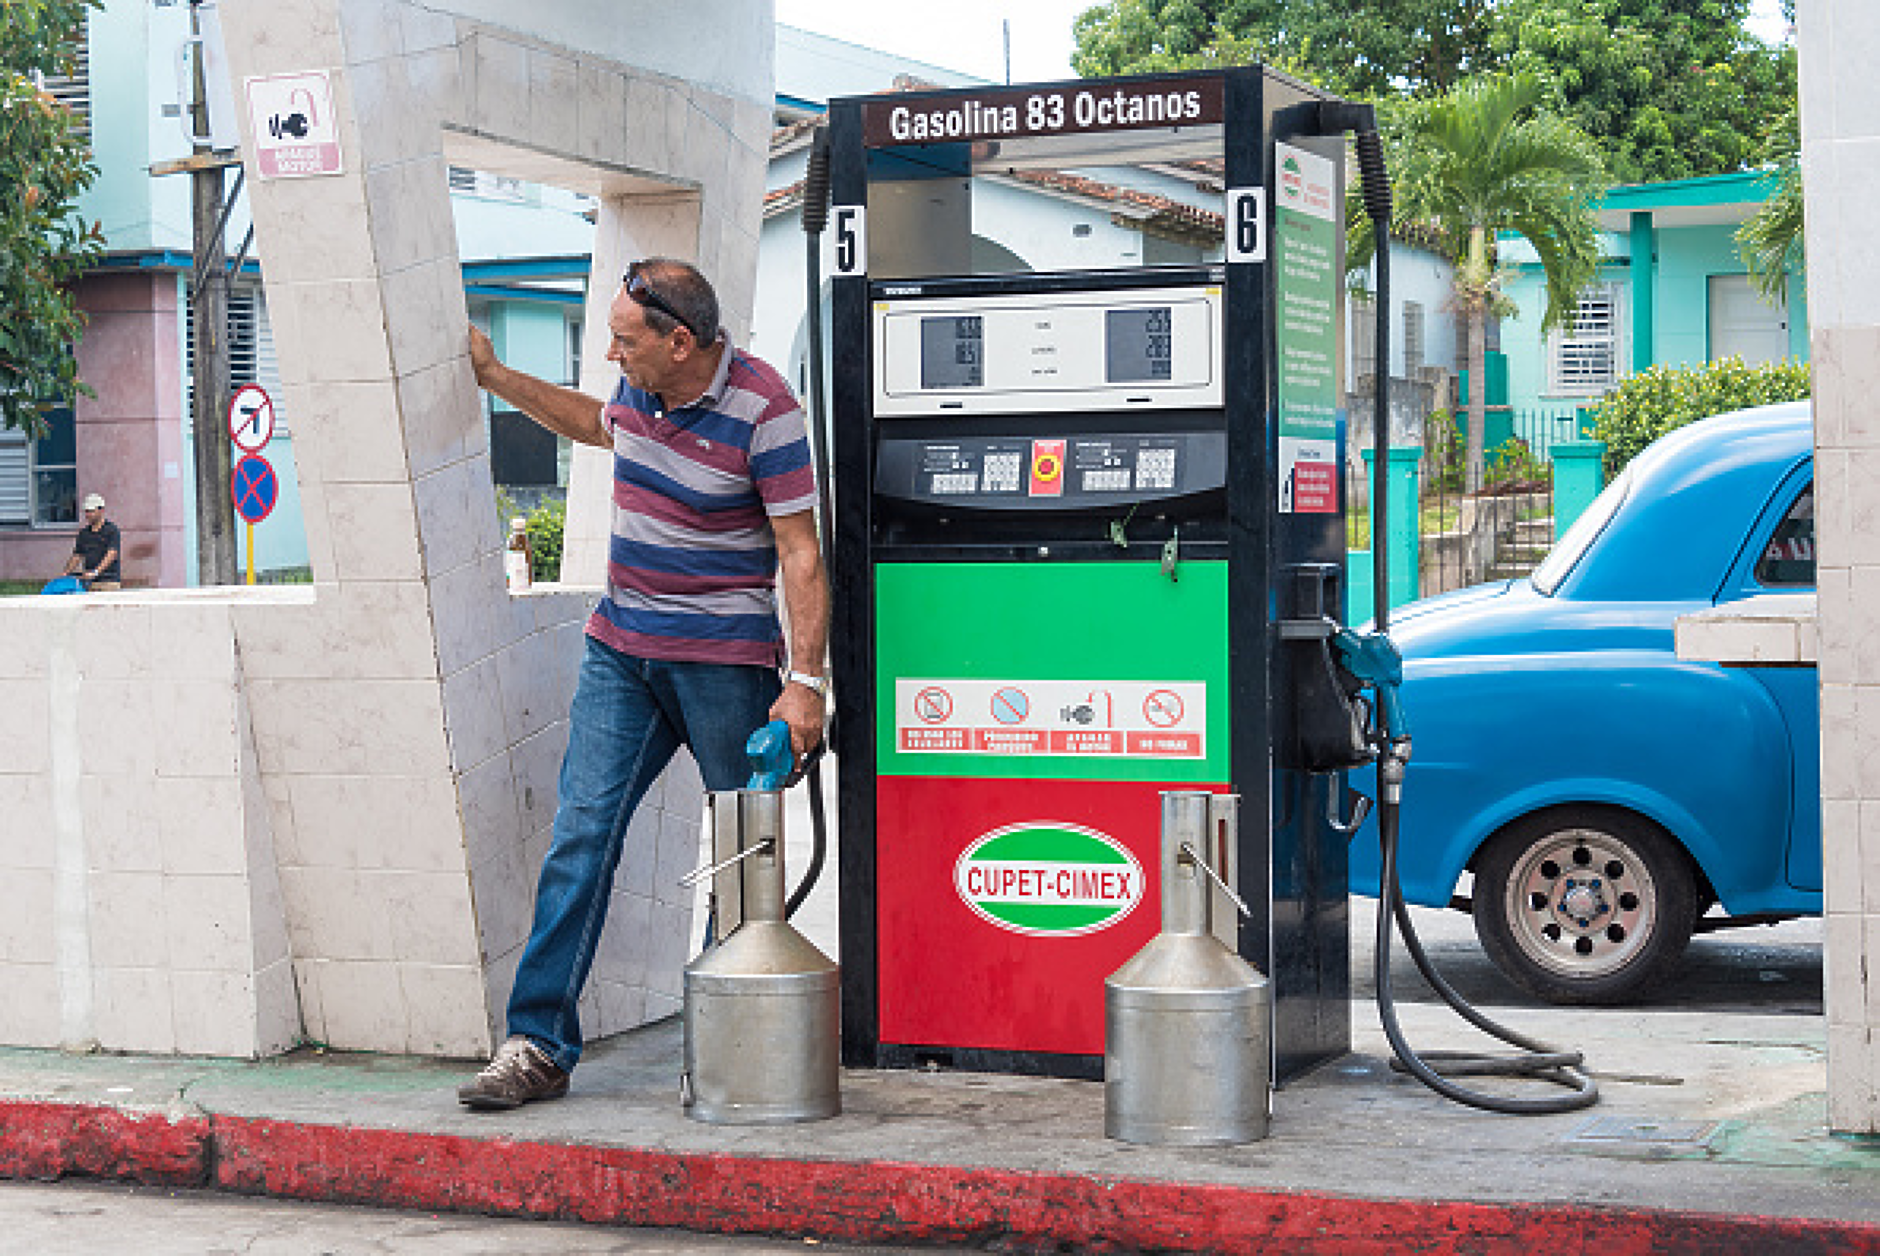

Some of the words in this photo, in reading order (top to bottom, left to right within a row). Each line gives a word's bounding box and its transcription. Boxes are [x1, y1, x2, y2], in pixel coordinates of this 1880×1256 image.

[890, 105, 1017, 139] Gasolina
[1026, 94, 1064, 131] 83
[1075, 88, 1200, 126] Octanos
[837, 210, 856, 273] 5
[1237, 194, 1257, 253] 6
[968, 867, 1131, 900] CUPET-CIMEX
